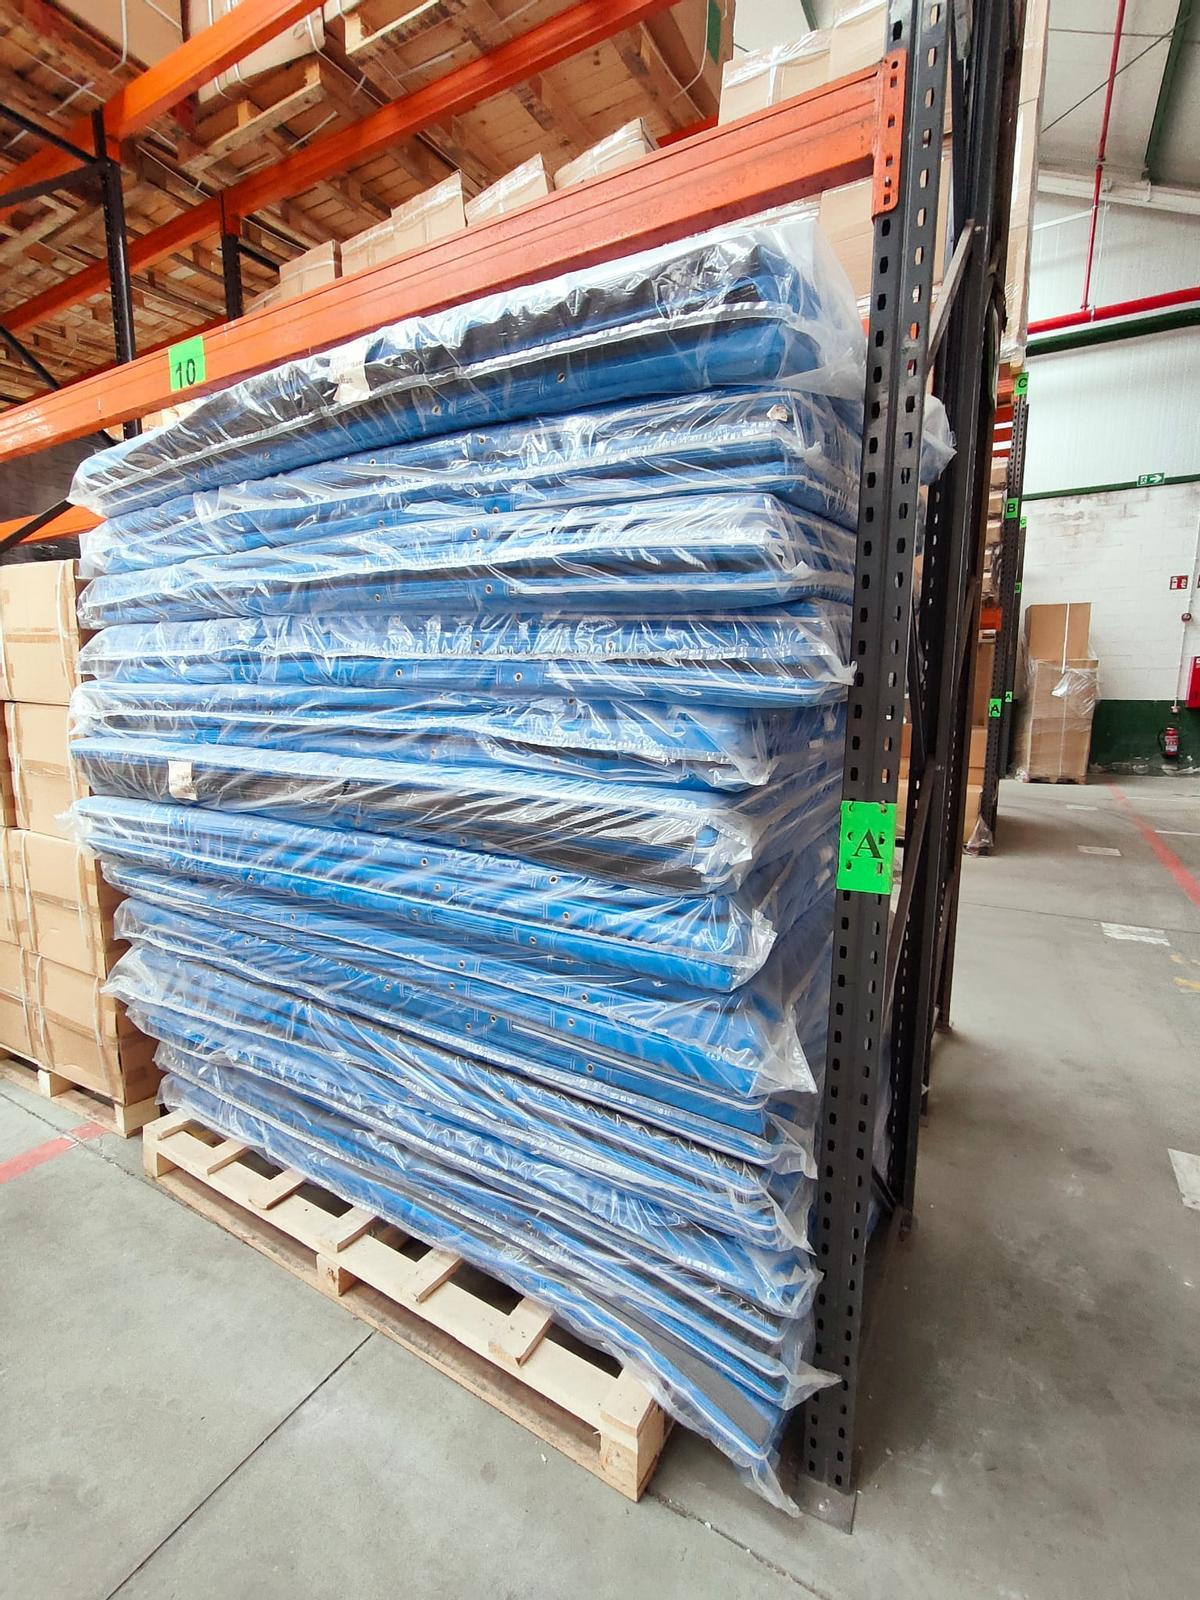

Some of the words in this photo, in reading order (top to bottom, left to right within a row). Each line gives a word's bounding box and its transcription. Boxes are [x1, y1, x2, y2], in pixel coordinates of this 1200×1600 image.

[175, 358, 196, 389] 10
[1018, 377, 1028, 388] C
[1007, 503, 1016, 513] B
[991, 704, 1000, 715] A
[851, 829, 885, 860] A
